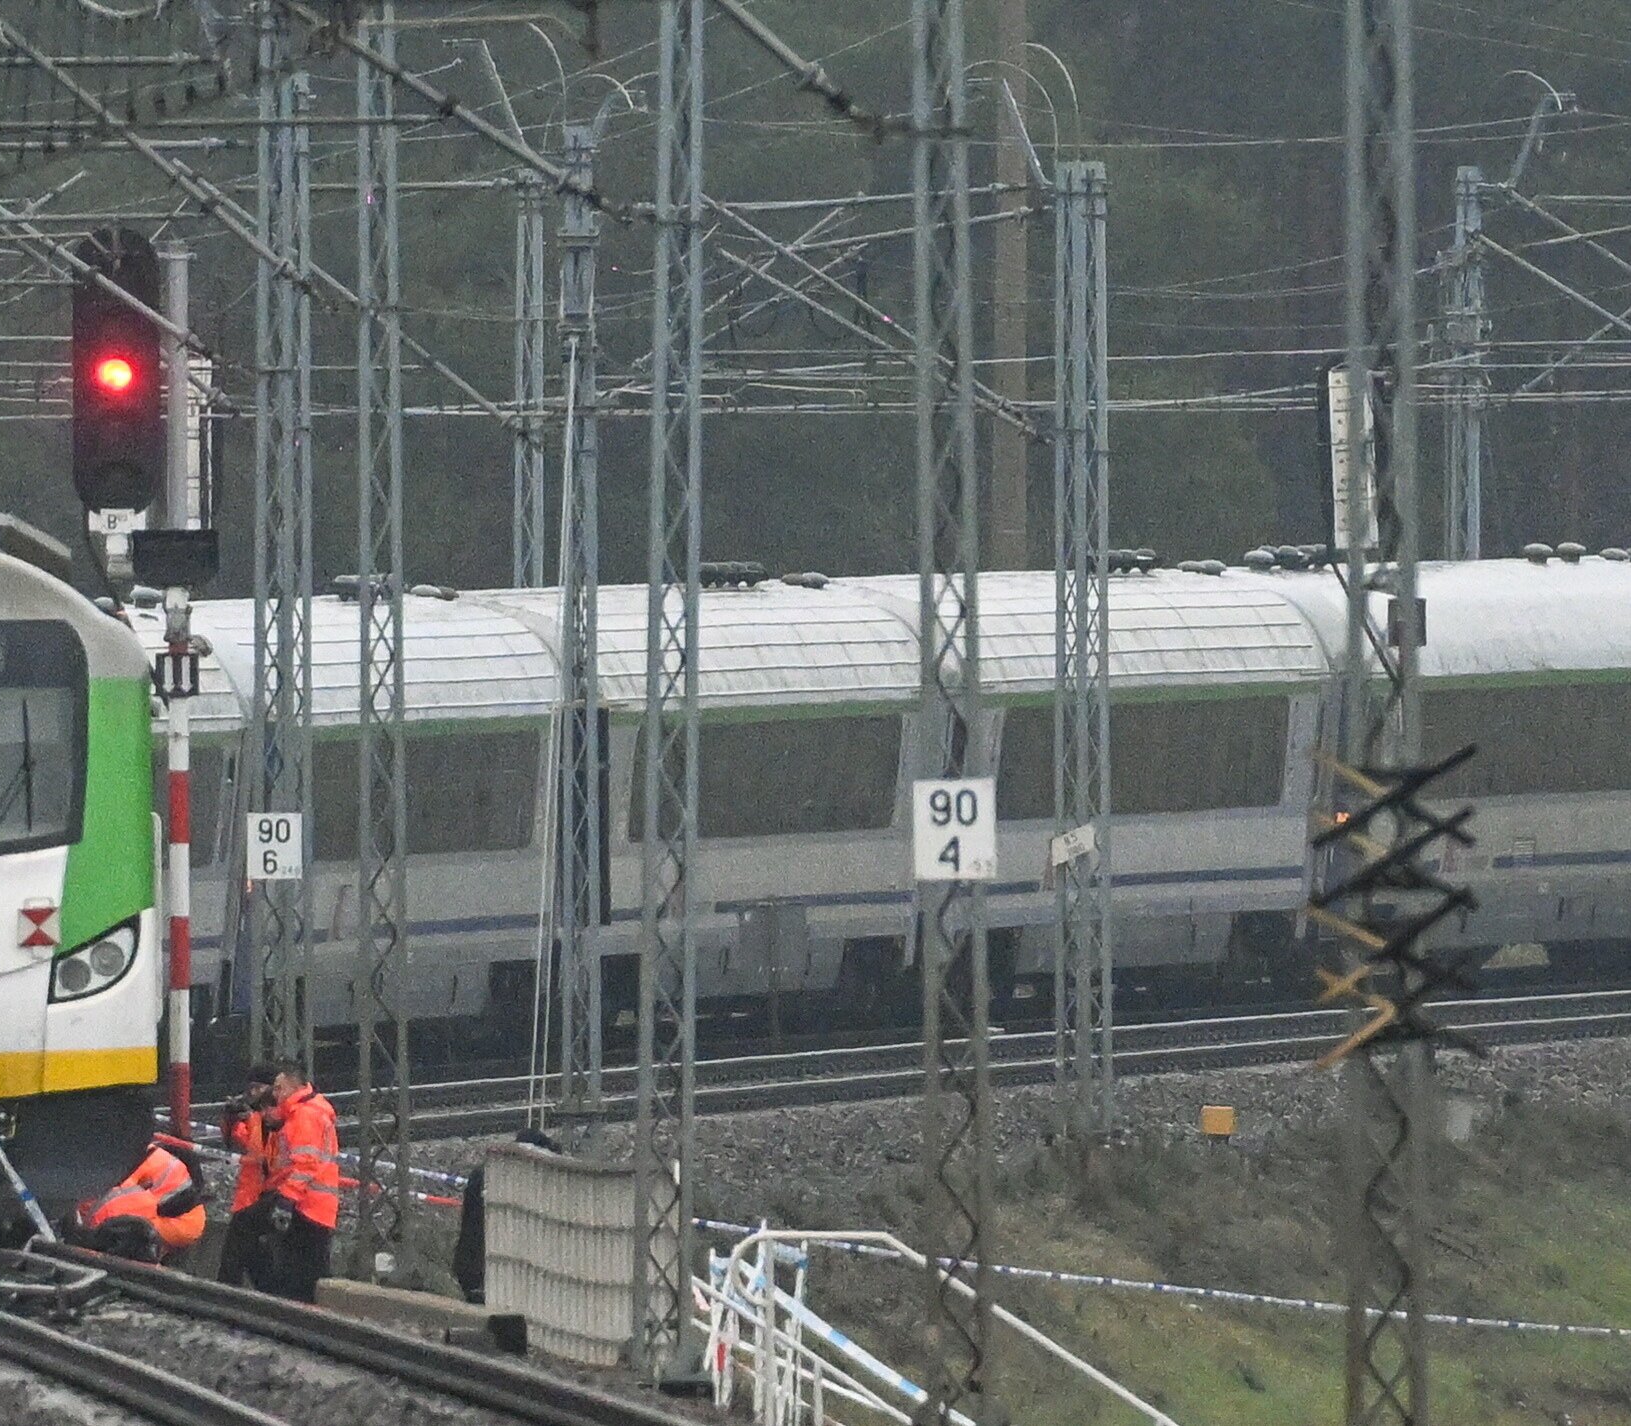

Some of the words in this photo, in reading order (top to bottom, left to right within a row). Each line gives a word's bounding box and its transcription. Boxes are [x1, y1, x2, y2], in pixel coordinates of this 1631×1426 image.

[929, 788, 978, 827] 90
[258, 818, 291, 843] 90
[263, 849, 278, 875] 6
[938, 835, 960, 872] 4
